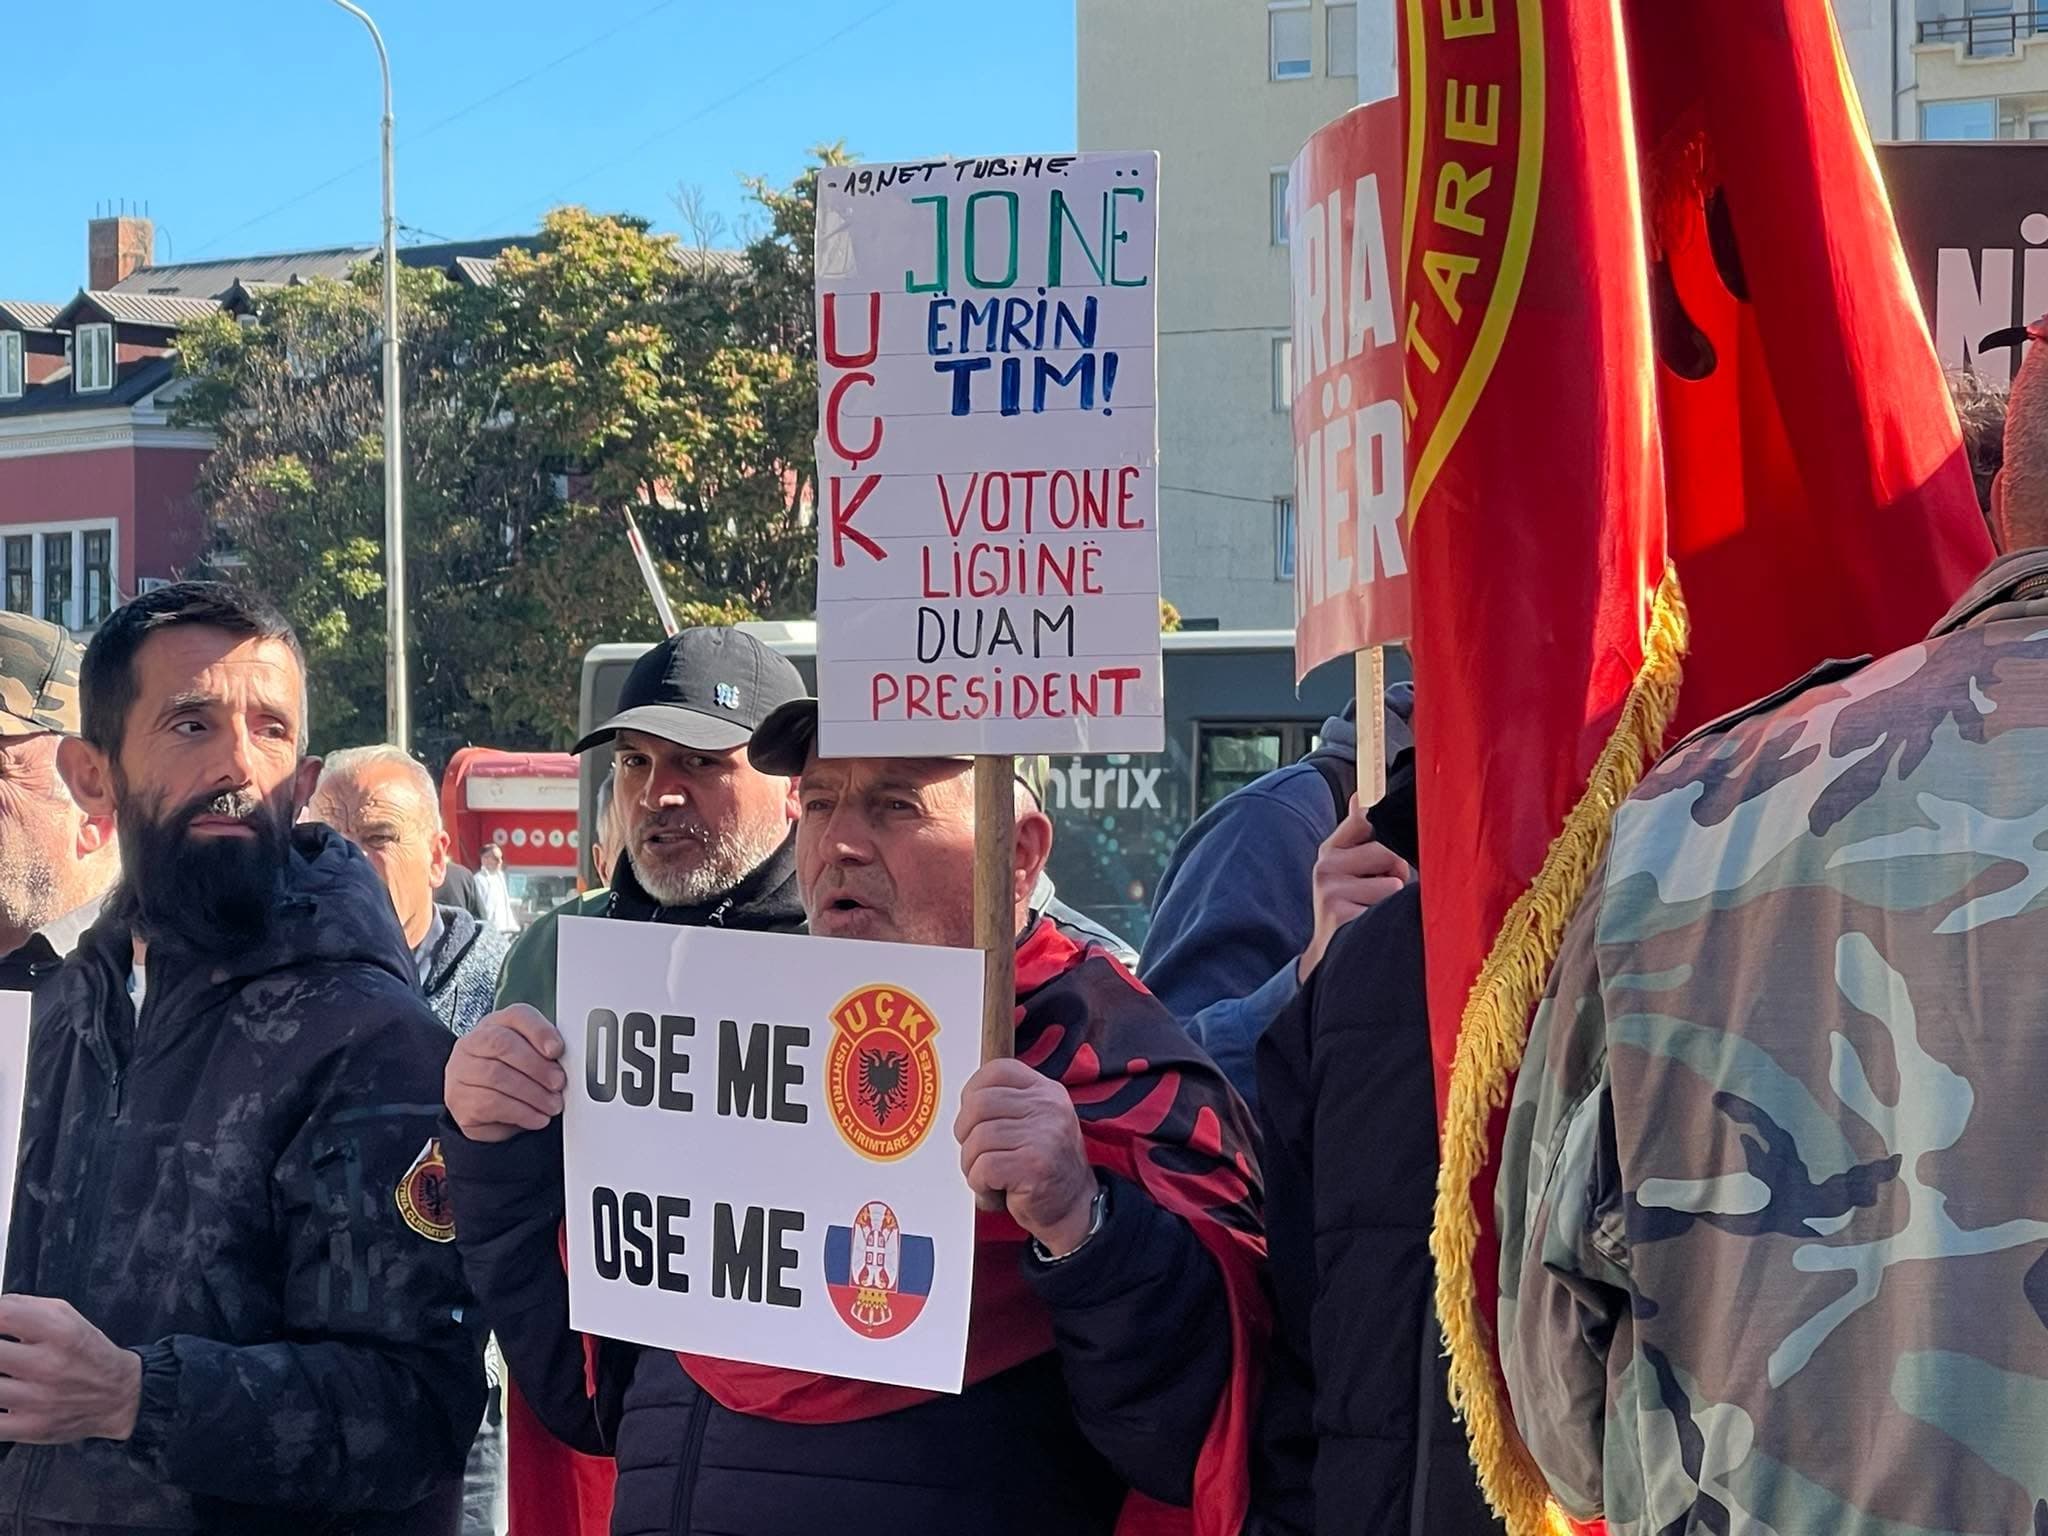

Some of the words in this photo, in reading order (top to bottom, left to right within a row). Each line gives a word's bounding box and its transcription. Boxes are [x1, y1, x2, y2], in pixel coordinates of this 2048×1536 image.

[1404, 79, 1500, 422] TARE
[934, 352, 1119, 417] TIM!
[936, 466, 1145, 537] VOTONE
[917, 604, 1074, 664] DUAM
[844, 991, 926, 1043] UÇK
[585, 1007, 696, 1113] OSE
[717, 1019, 810, 1125] ME
[832, 1042, 850, 1115] USHTRIA
[841, 1114, 910, 1153] ÇLIRIMTARE
[909, 1125, 919, 1139] E
[592, 1185, 691, 1294] OSE
[711, 1202, 805, 1309] ME
